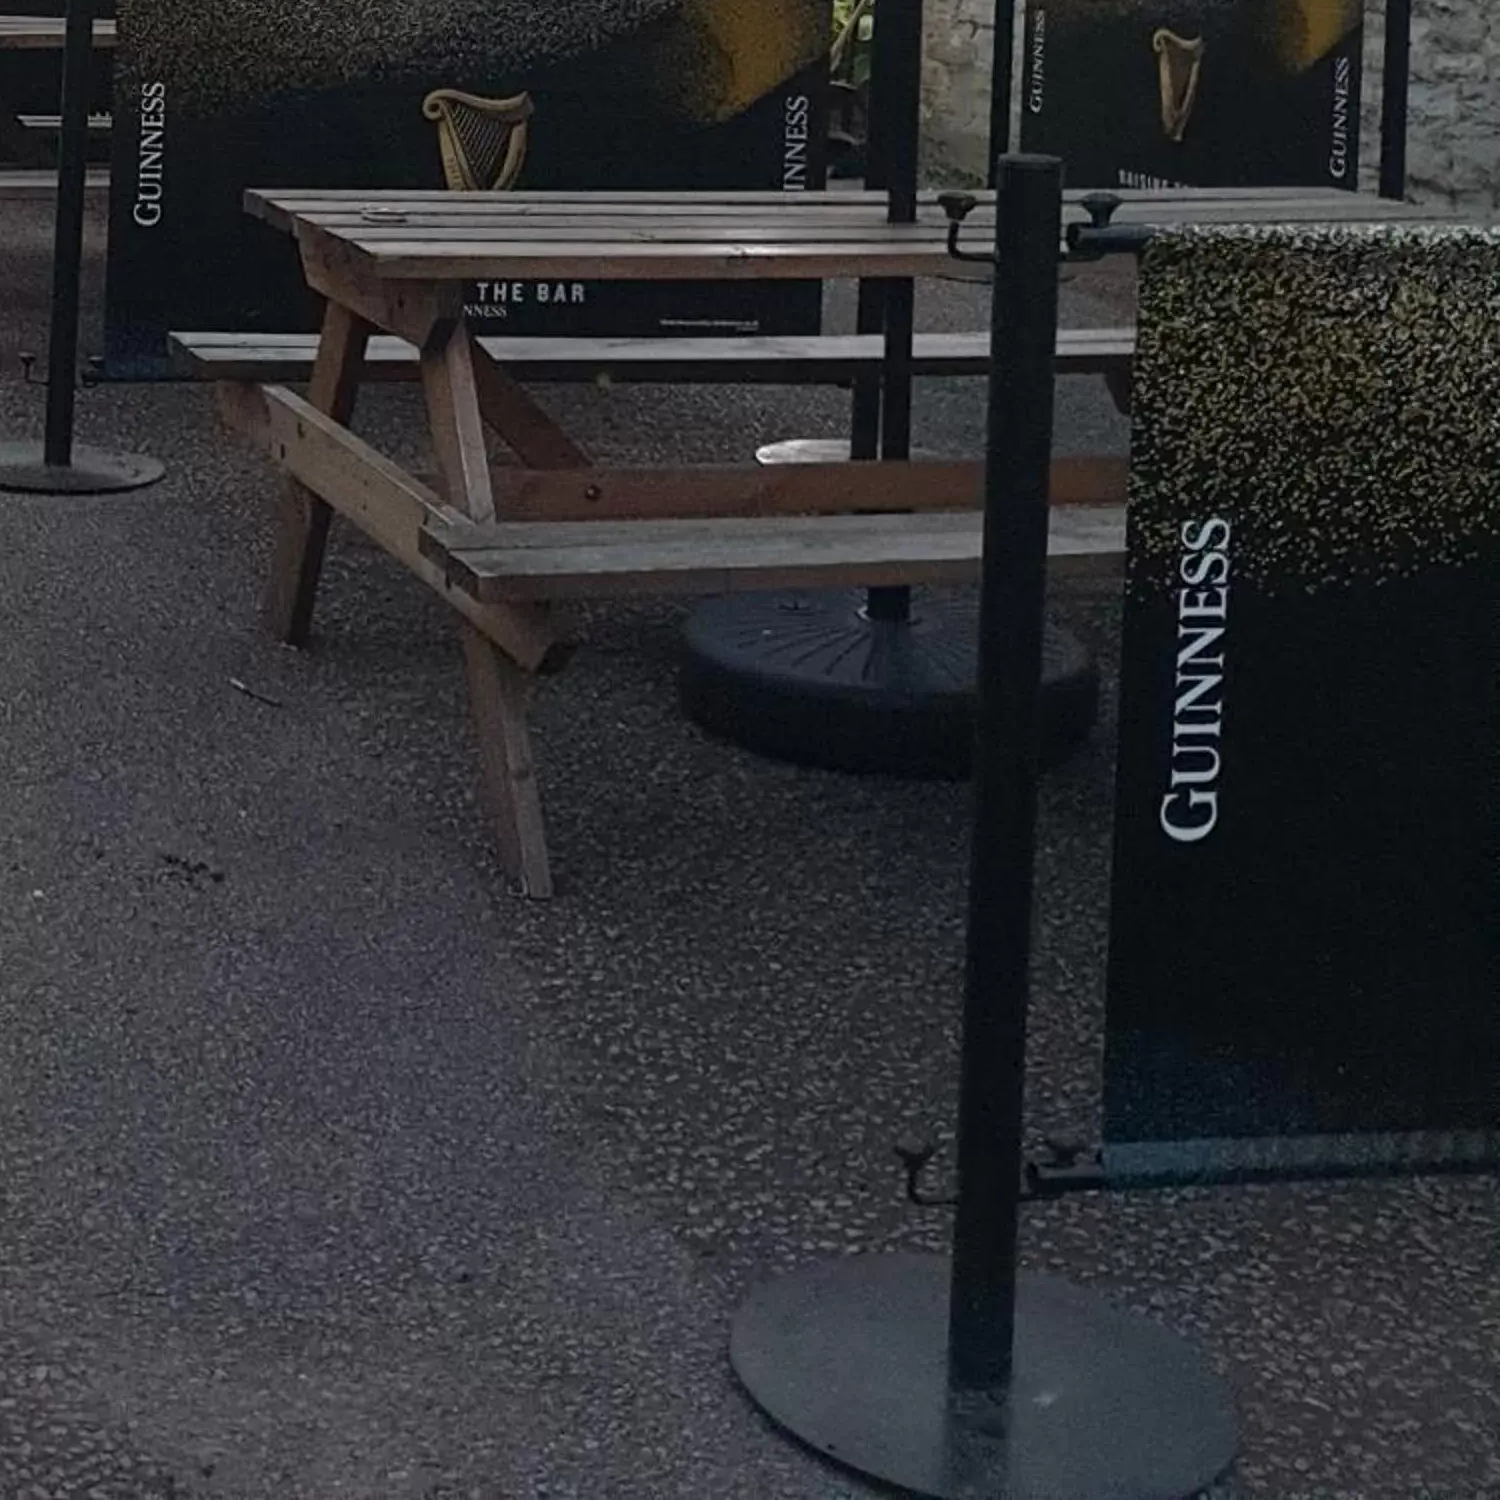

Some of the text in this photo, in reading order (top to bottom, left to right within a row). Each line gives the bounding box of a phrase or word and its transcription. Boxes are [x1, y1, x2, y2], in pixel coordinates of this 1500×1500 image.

[1029, 9, 1046, 114] GUINNESS
[1328, 55, 1350, 179] GUINNESS
[133, 82, 166, 227] GUINNESS
[476, 282, 586, 303] THE BAR
[1159, 517, 1232, 843] GUINNESS
